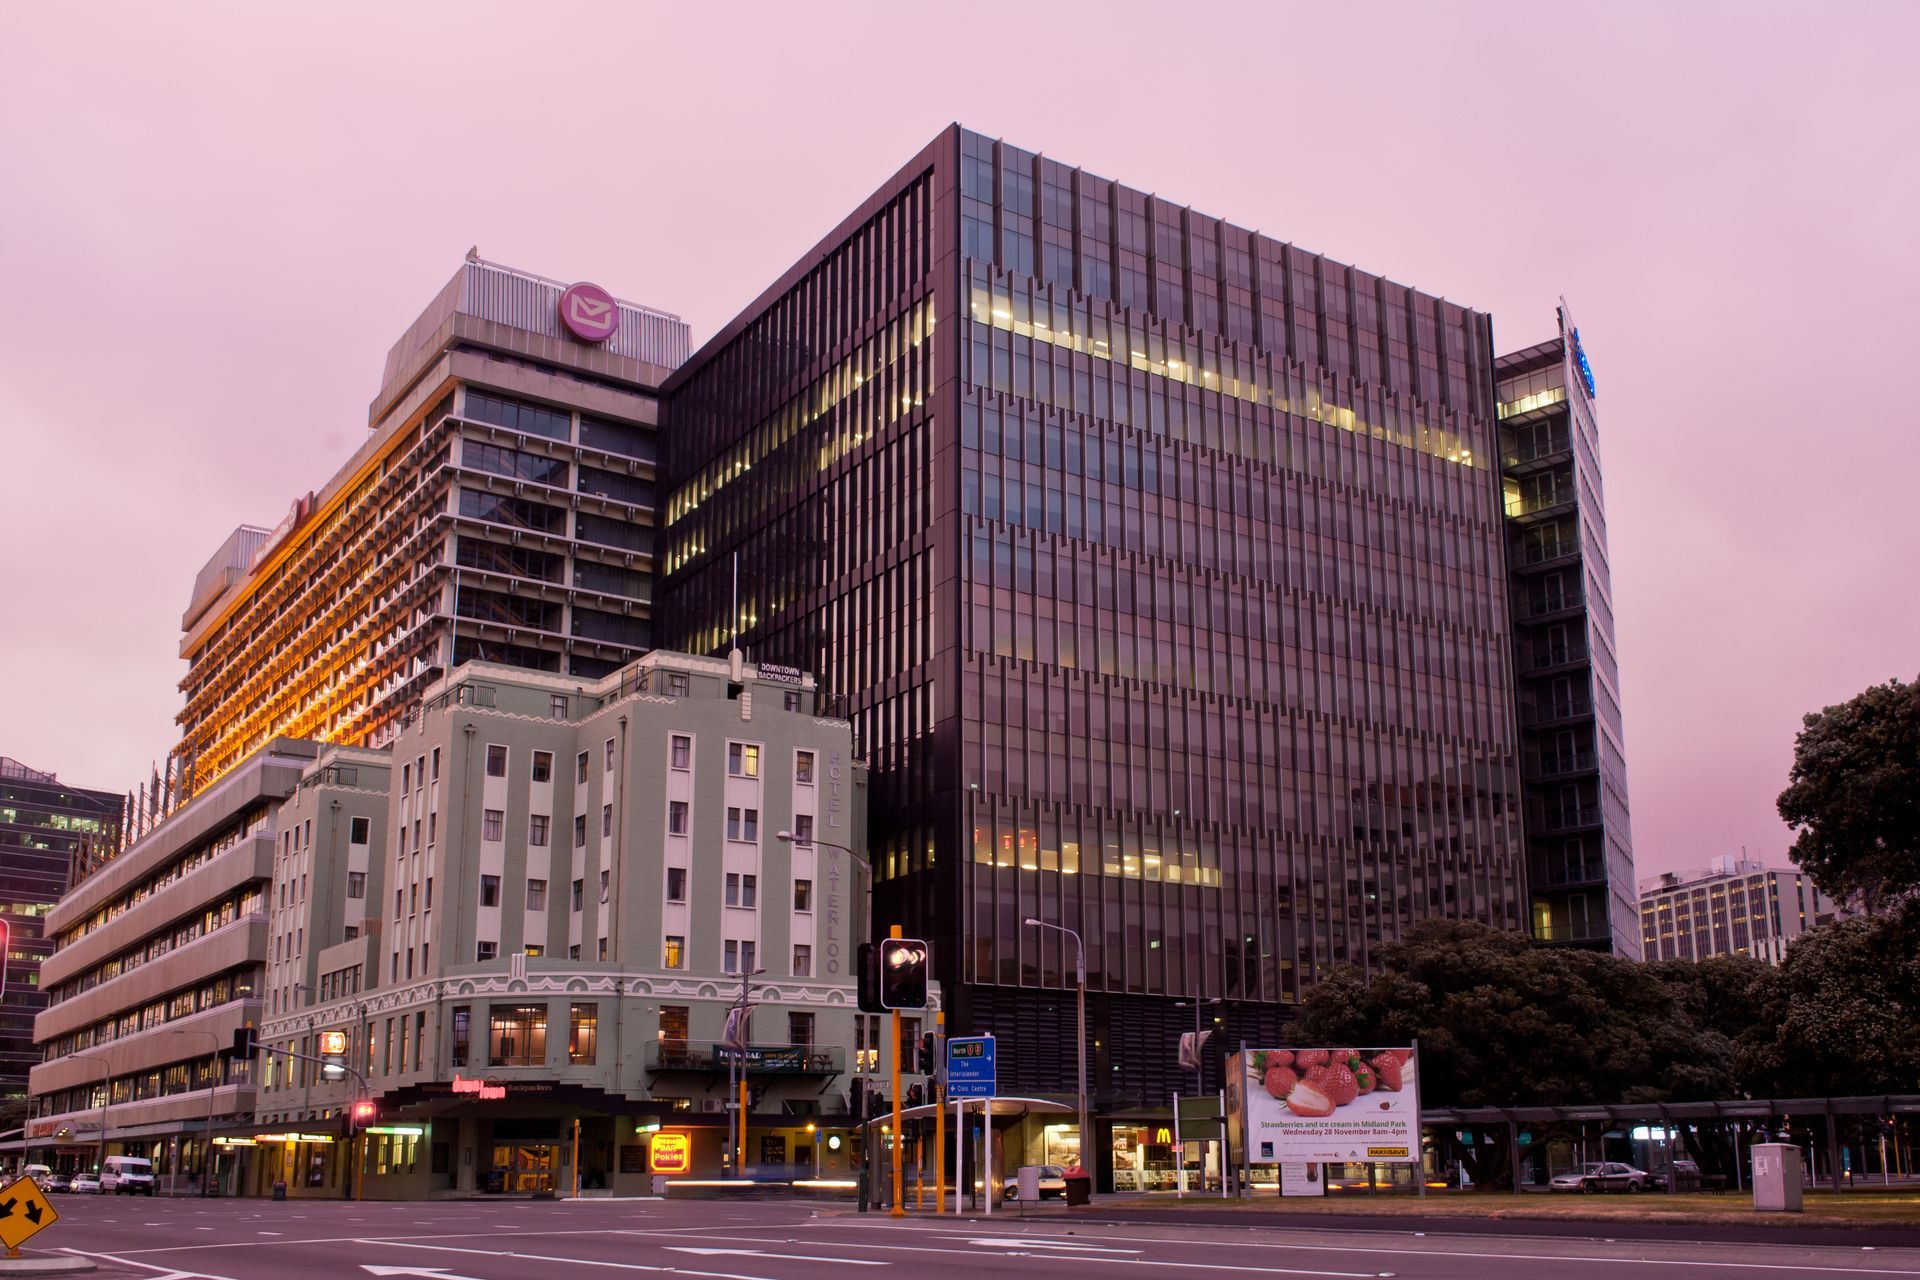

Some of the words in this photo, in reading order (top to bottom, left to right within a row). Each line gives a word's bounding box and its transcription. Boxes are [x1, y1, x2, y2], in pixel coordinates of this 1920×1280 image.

[761, 663, 800, 675] DOWNTOWN
[758, 671, 802, 684] BACKPACKERS
[829, 751, 841, 828] HOTEL
[826, 847, 840, 974] WATERLOO
[508, 1083, 552, 1092] Backpackers
[1282, 1128, 1323, 1136] Wednesday
[1324, 1128, 1333, 1136] 28
[1334, 1128, 1371, 1136] November
[655, 1153, 683, 1161] Pokies
